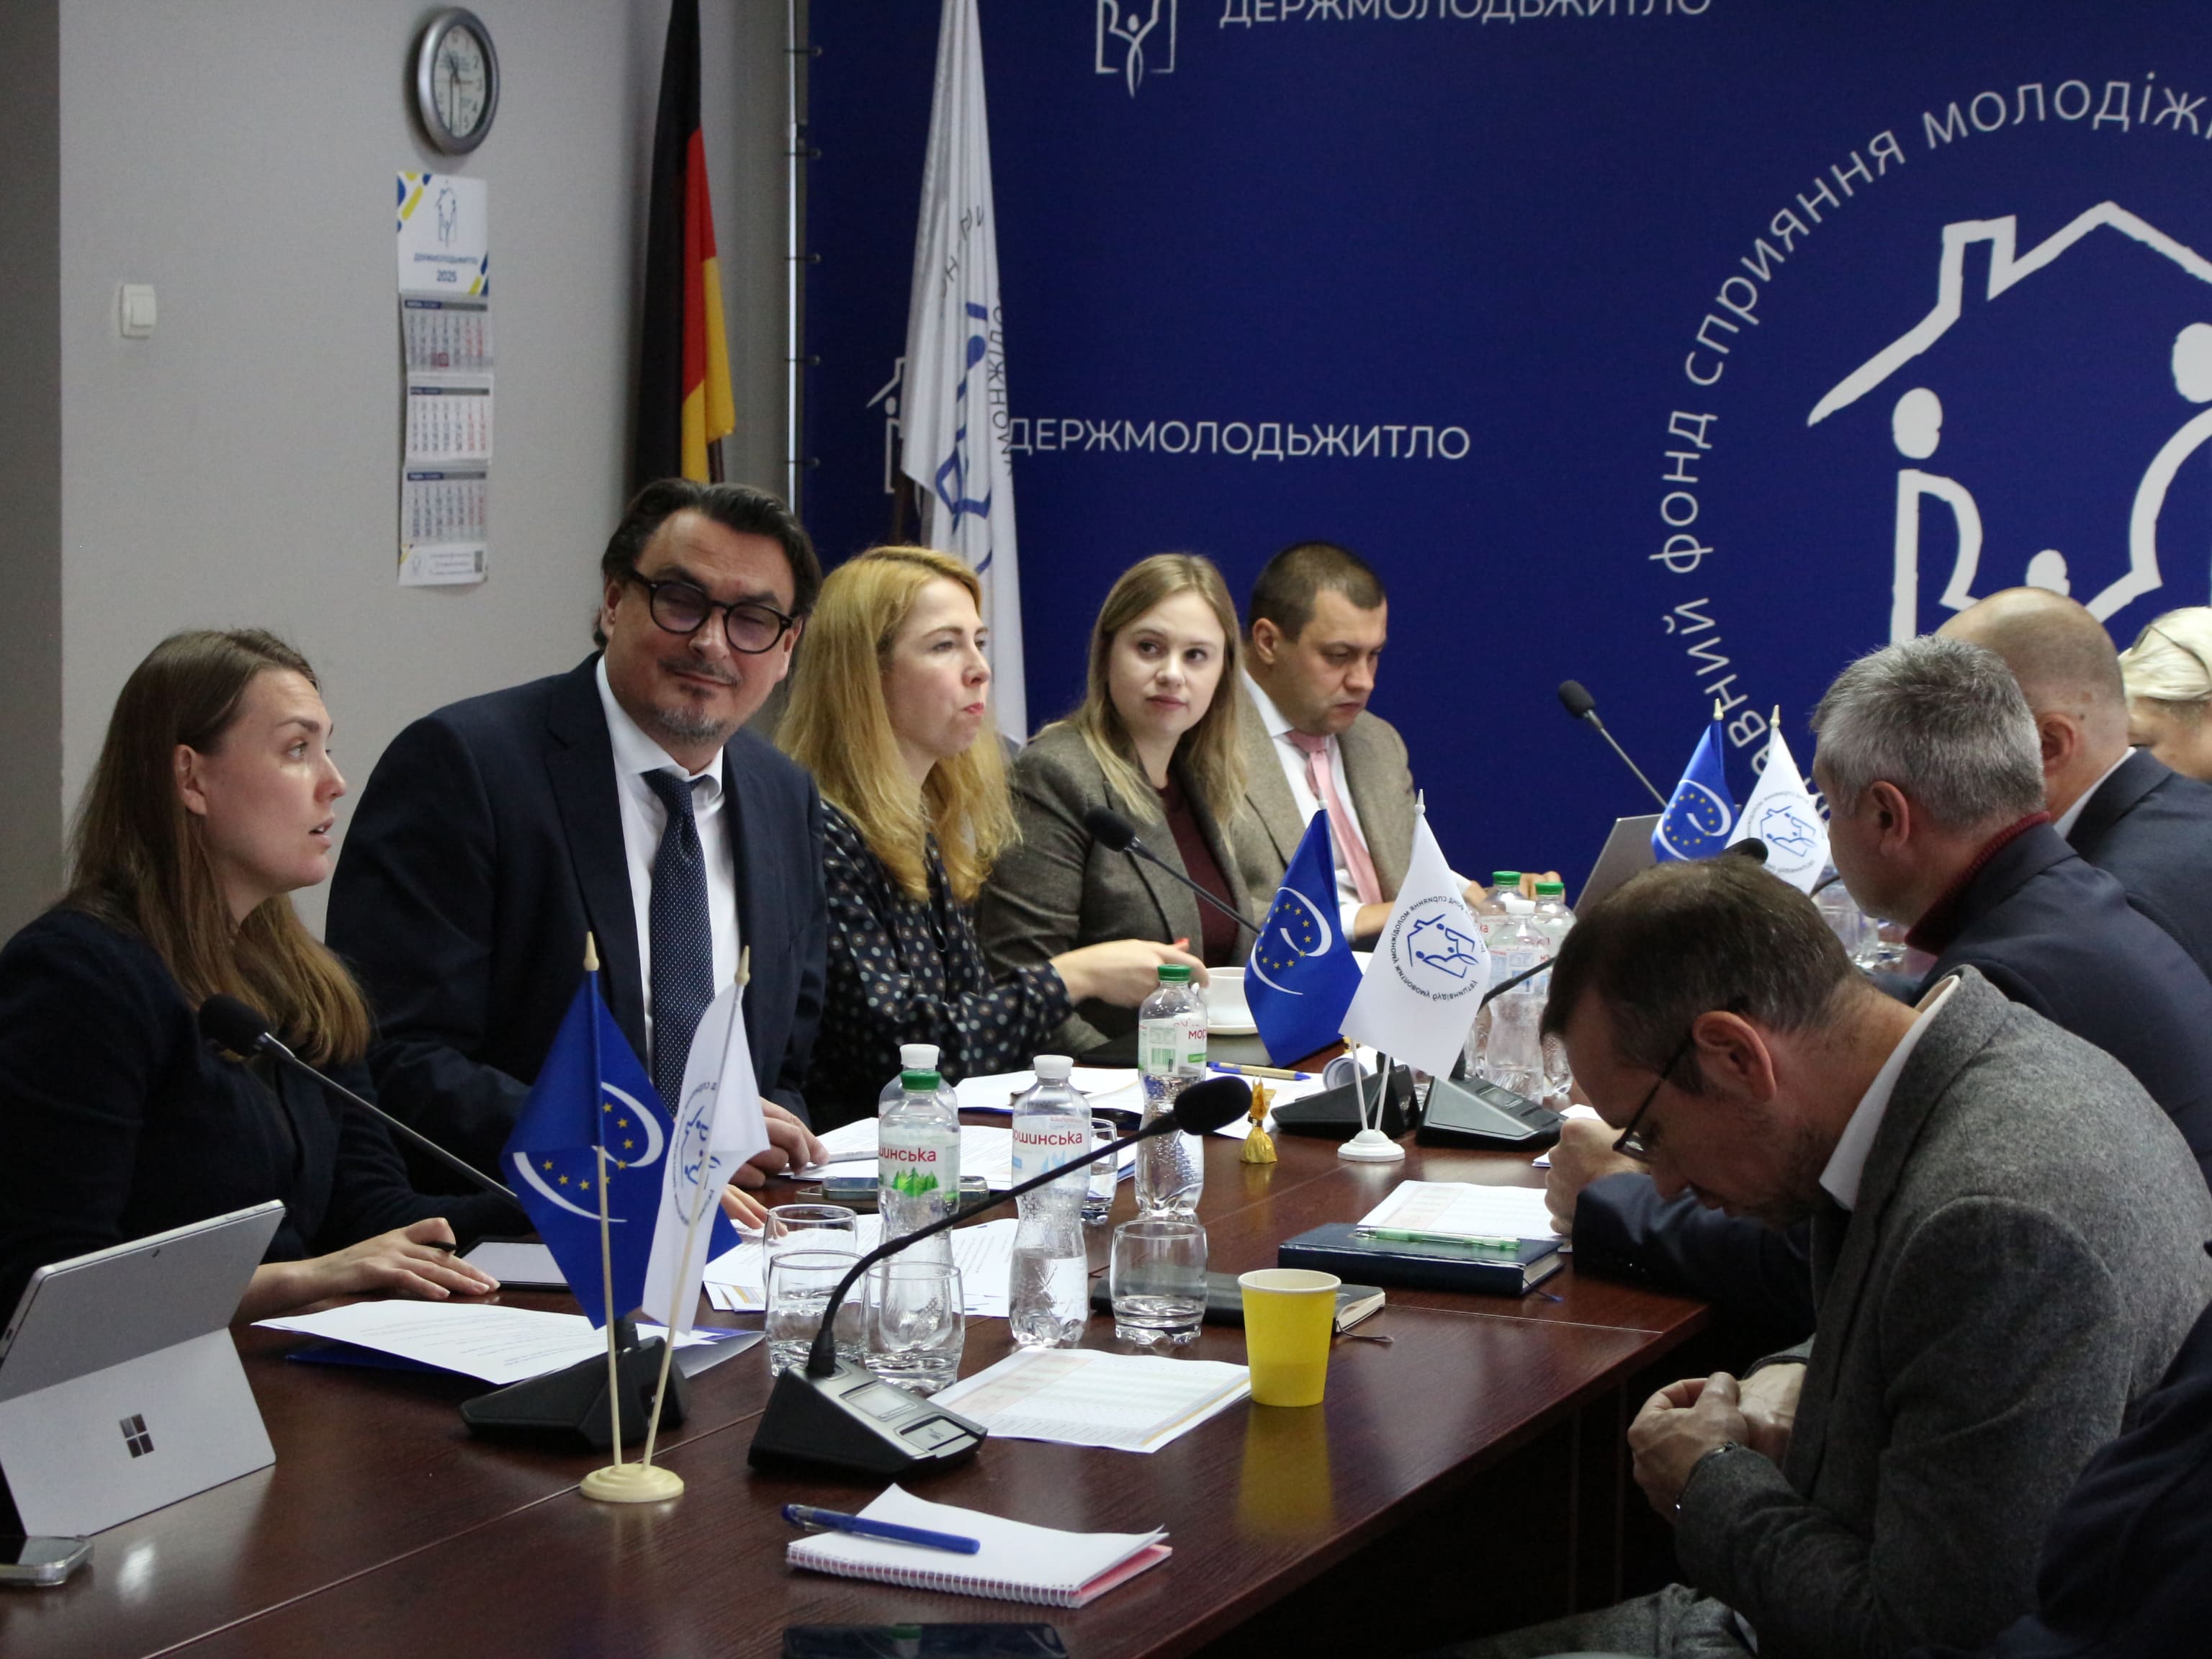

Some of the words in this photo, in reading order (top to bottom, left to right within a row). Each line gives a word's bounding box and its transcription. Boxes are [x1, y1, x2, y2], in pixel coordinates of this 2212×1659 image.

[1010, 418, 1470, 462] ДЕРЖМОЛОДЬЖИТЛО
[1649, 410, 1718, 574] фонд
[1685, 130, 1905, 385] сприяння
